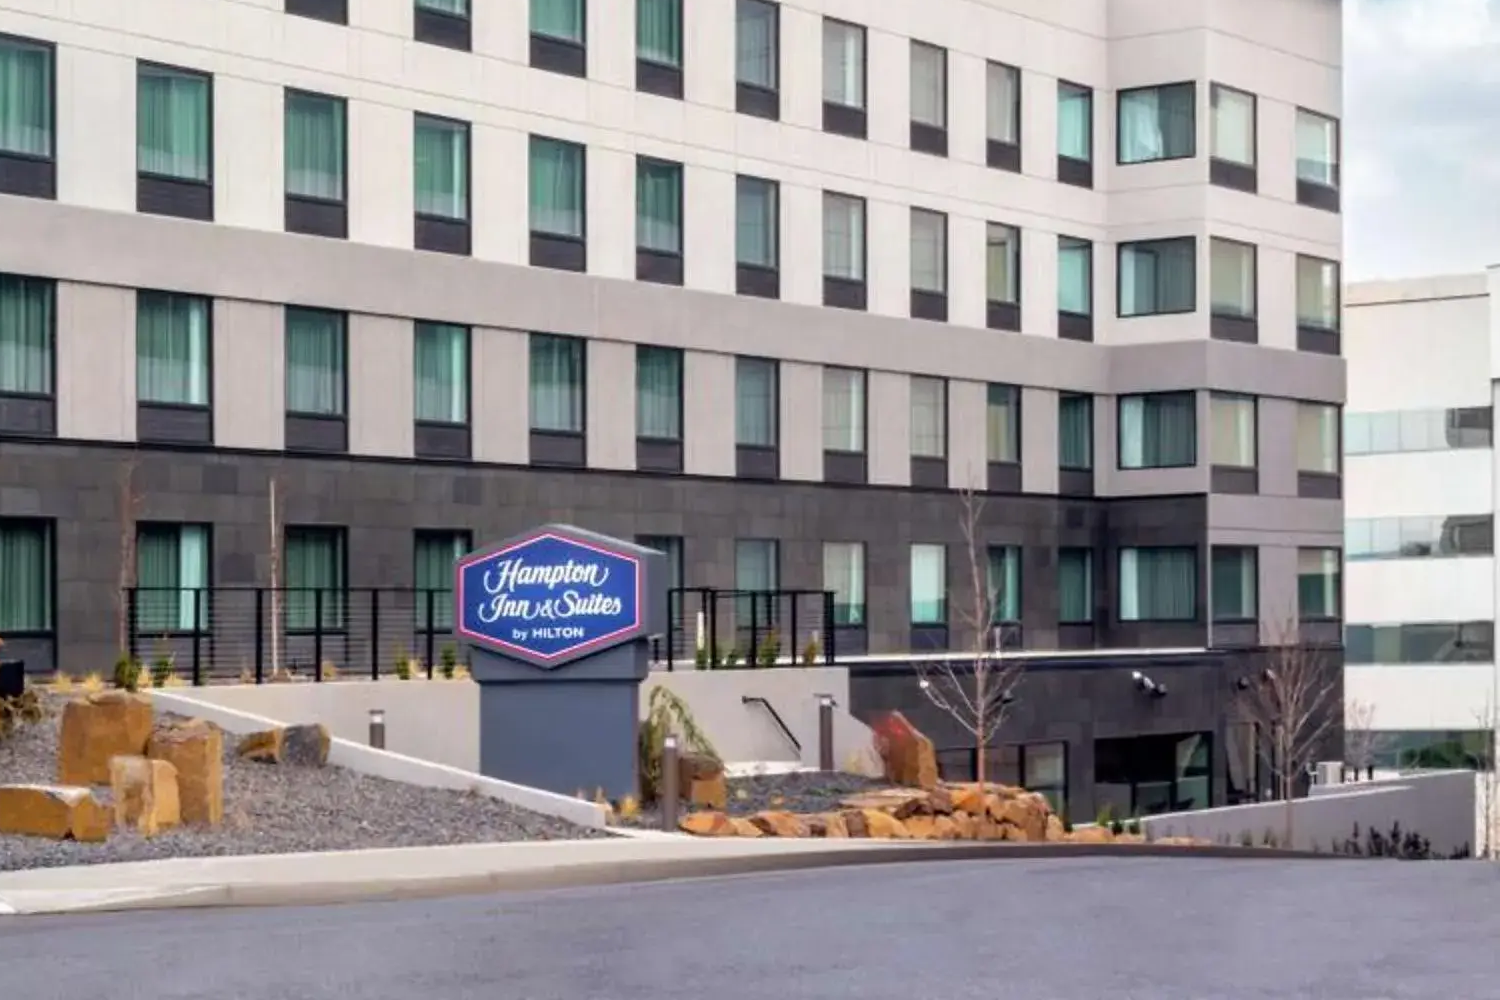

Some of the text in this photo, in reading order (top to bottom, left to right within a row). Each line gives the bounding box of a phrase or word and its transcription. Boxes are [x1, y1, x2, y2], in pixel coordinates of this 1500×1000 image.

[484, 557, 610, 594] Hampton
[478, 590, 622, 622] Inn & Suites
[512, 627, 585, 641] by HILTON
